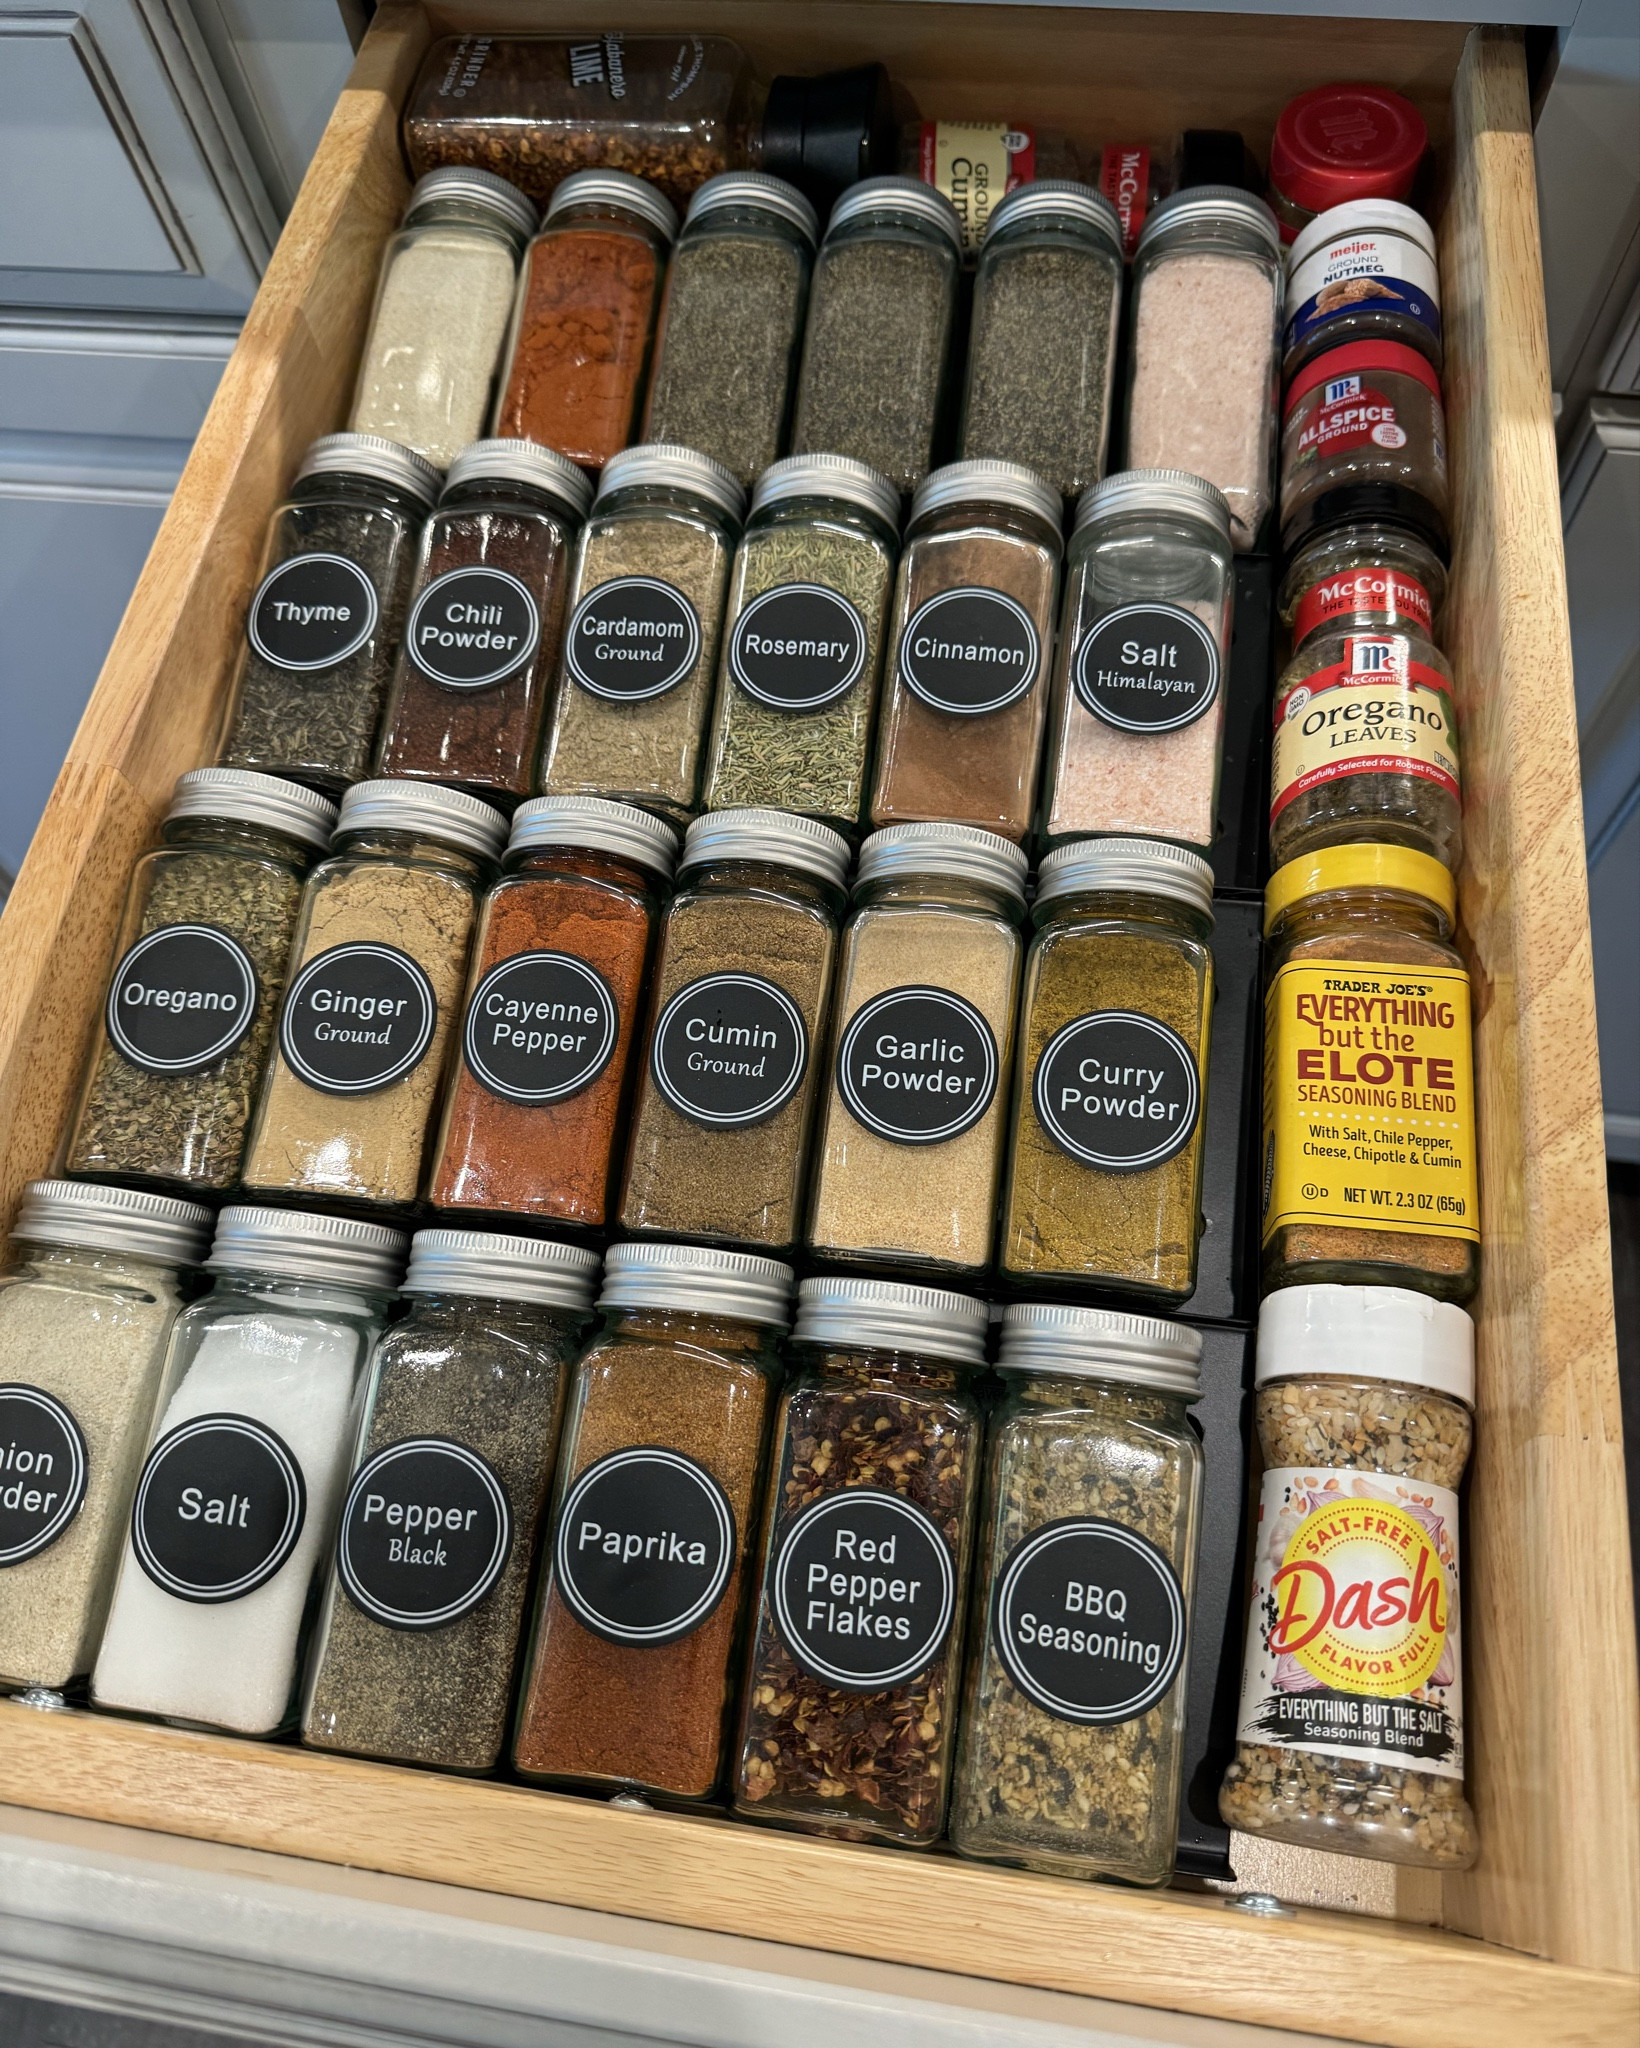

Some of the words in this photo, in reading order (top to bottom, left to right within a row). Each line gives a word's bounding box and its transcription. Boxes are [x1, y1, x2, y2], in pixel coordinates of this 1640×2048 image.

[569, 43, 604, 87] LIME
[602, 31, 627, 100] Habanero
[1323, 264, 1384, 285] NUTMEG
[1327, 255, 1379, 273] GROUND
[1298, 407, 1395, 451] ALLSPICE
[1317, 422, 1369, 444] GROUND
[274, 603, 350, 625] Thyme
[447, 604, 502, 624] Chili
[1322, 600, 1344, 614] THE
[1348, 595, 1385, 605] TASTE
[421, 627, 517, 650] Powder
[583, 616, 683, 638] Cardamom
[595, 644, 664, 661] Ground
[746, 635, 849, 662] Rosemary
[915, 638, 1023, 665] Cinnamon
[1121, 642, 1176, 667] Salt
[1098, 671, 1195, 696] Himalayan
[1289, 692, 1304, 706] NON
[1302, 700, 1442, 737] Oregano
[1329, 726, 1417, 748] LEAVES
[1298, 766, 1336, 788] Carefully
[1337, 759, 1378, 772] Selected
[1379, 759, 1393, 767] for
[1395, 759, 1425, 772] Robust
[125, 983, 237, 1013] Oregano
[1323, 980, 1381, 993] TRADER
[311, 989, 407, 1020] Ginger
[486, 994, 597, 1023] Cayenne
[1297, 994, 1455, 1029] EVERYTHING
[315, 1023, 392, 1044] Ground
[493, 1024, 586, 1055] Pepper
[686, 1019, 776, 1048] Cumin
[1319, 1022, 1364, 1049] but
[1370, 1025, 1415, 1052] the
[876, 1035, 964, 1063] Garlic
[688, 1052, 765, 1077] Ground
[1079, 1059, 1164, 1090] Curry
[1297, 1049, 1455, 1090] ELOTE
[862, 1065, 975, 1094] Powder
[1062, 1088, 1179, 1120] Powder
[1297, 1084, 1397, 1108] SEASONING
[1401, 1091, 1456, 1113] BLEND
[1309, 1124, 1339, 1139] With
[1343, 1127, 1371, 1144] Salt,
[1373, 1129, 1404, 1145] Chile
[1407, 1132, 1453, 1151] Pepper,
[1303, 1142, 1351, 1160] Cheese,
[1354, 1146, 1406, 1165] Chipotle
[1409, 1153, 1420, 1165] &
[1423, 1153, 1462, 1169] Cumin
[1344, 1187, 1367, 1204] NET
[1370, 1190, 1393, 1206] WT.
[1396, 1192, 1414, 1208] 2.3
[1417, 1194, 1434, 1210] OZ
[1436, 1196, 1466, 1216] (65g)
[0, 1440, 54, 1475] nion
[0, 1481, 58, 1514] der
[179, 1488, 250, 1527] Salt
[364, 1495, 477, 1534] Pepper
[579, 1522, 705, 1565] Paprika
[835, 1530, 895, 1563] Red
[1306, 1516, 1413, 1555] SALT-FREE
[389, 1537, 446, 1565] Black
[808, 1564, 920, 1606] Pepper
[1066, 1582, 1126, 1622] BBQ
[1269, 1546, 1446, 1654] Dash
[807, 1601, 909, 1639] Flakes
[1018, 1612, 1161, 1674] Seasoning
[1320, 1643, 1394, 1675] FLAVOR
[1399, 1634, 1430, 1668] FULL
[1279, 1698, 1358, 1724] EVERYTHING
[1362, 1703, 1390, 1727] BUT
[1392, 1706, 1416, 1730] THE
[1419, 1710, 1442, 1734] SALT
[1304, 1722, 1380, 1745] Seasoning
[1384, 1728, 1423, 1747] Blend
